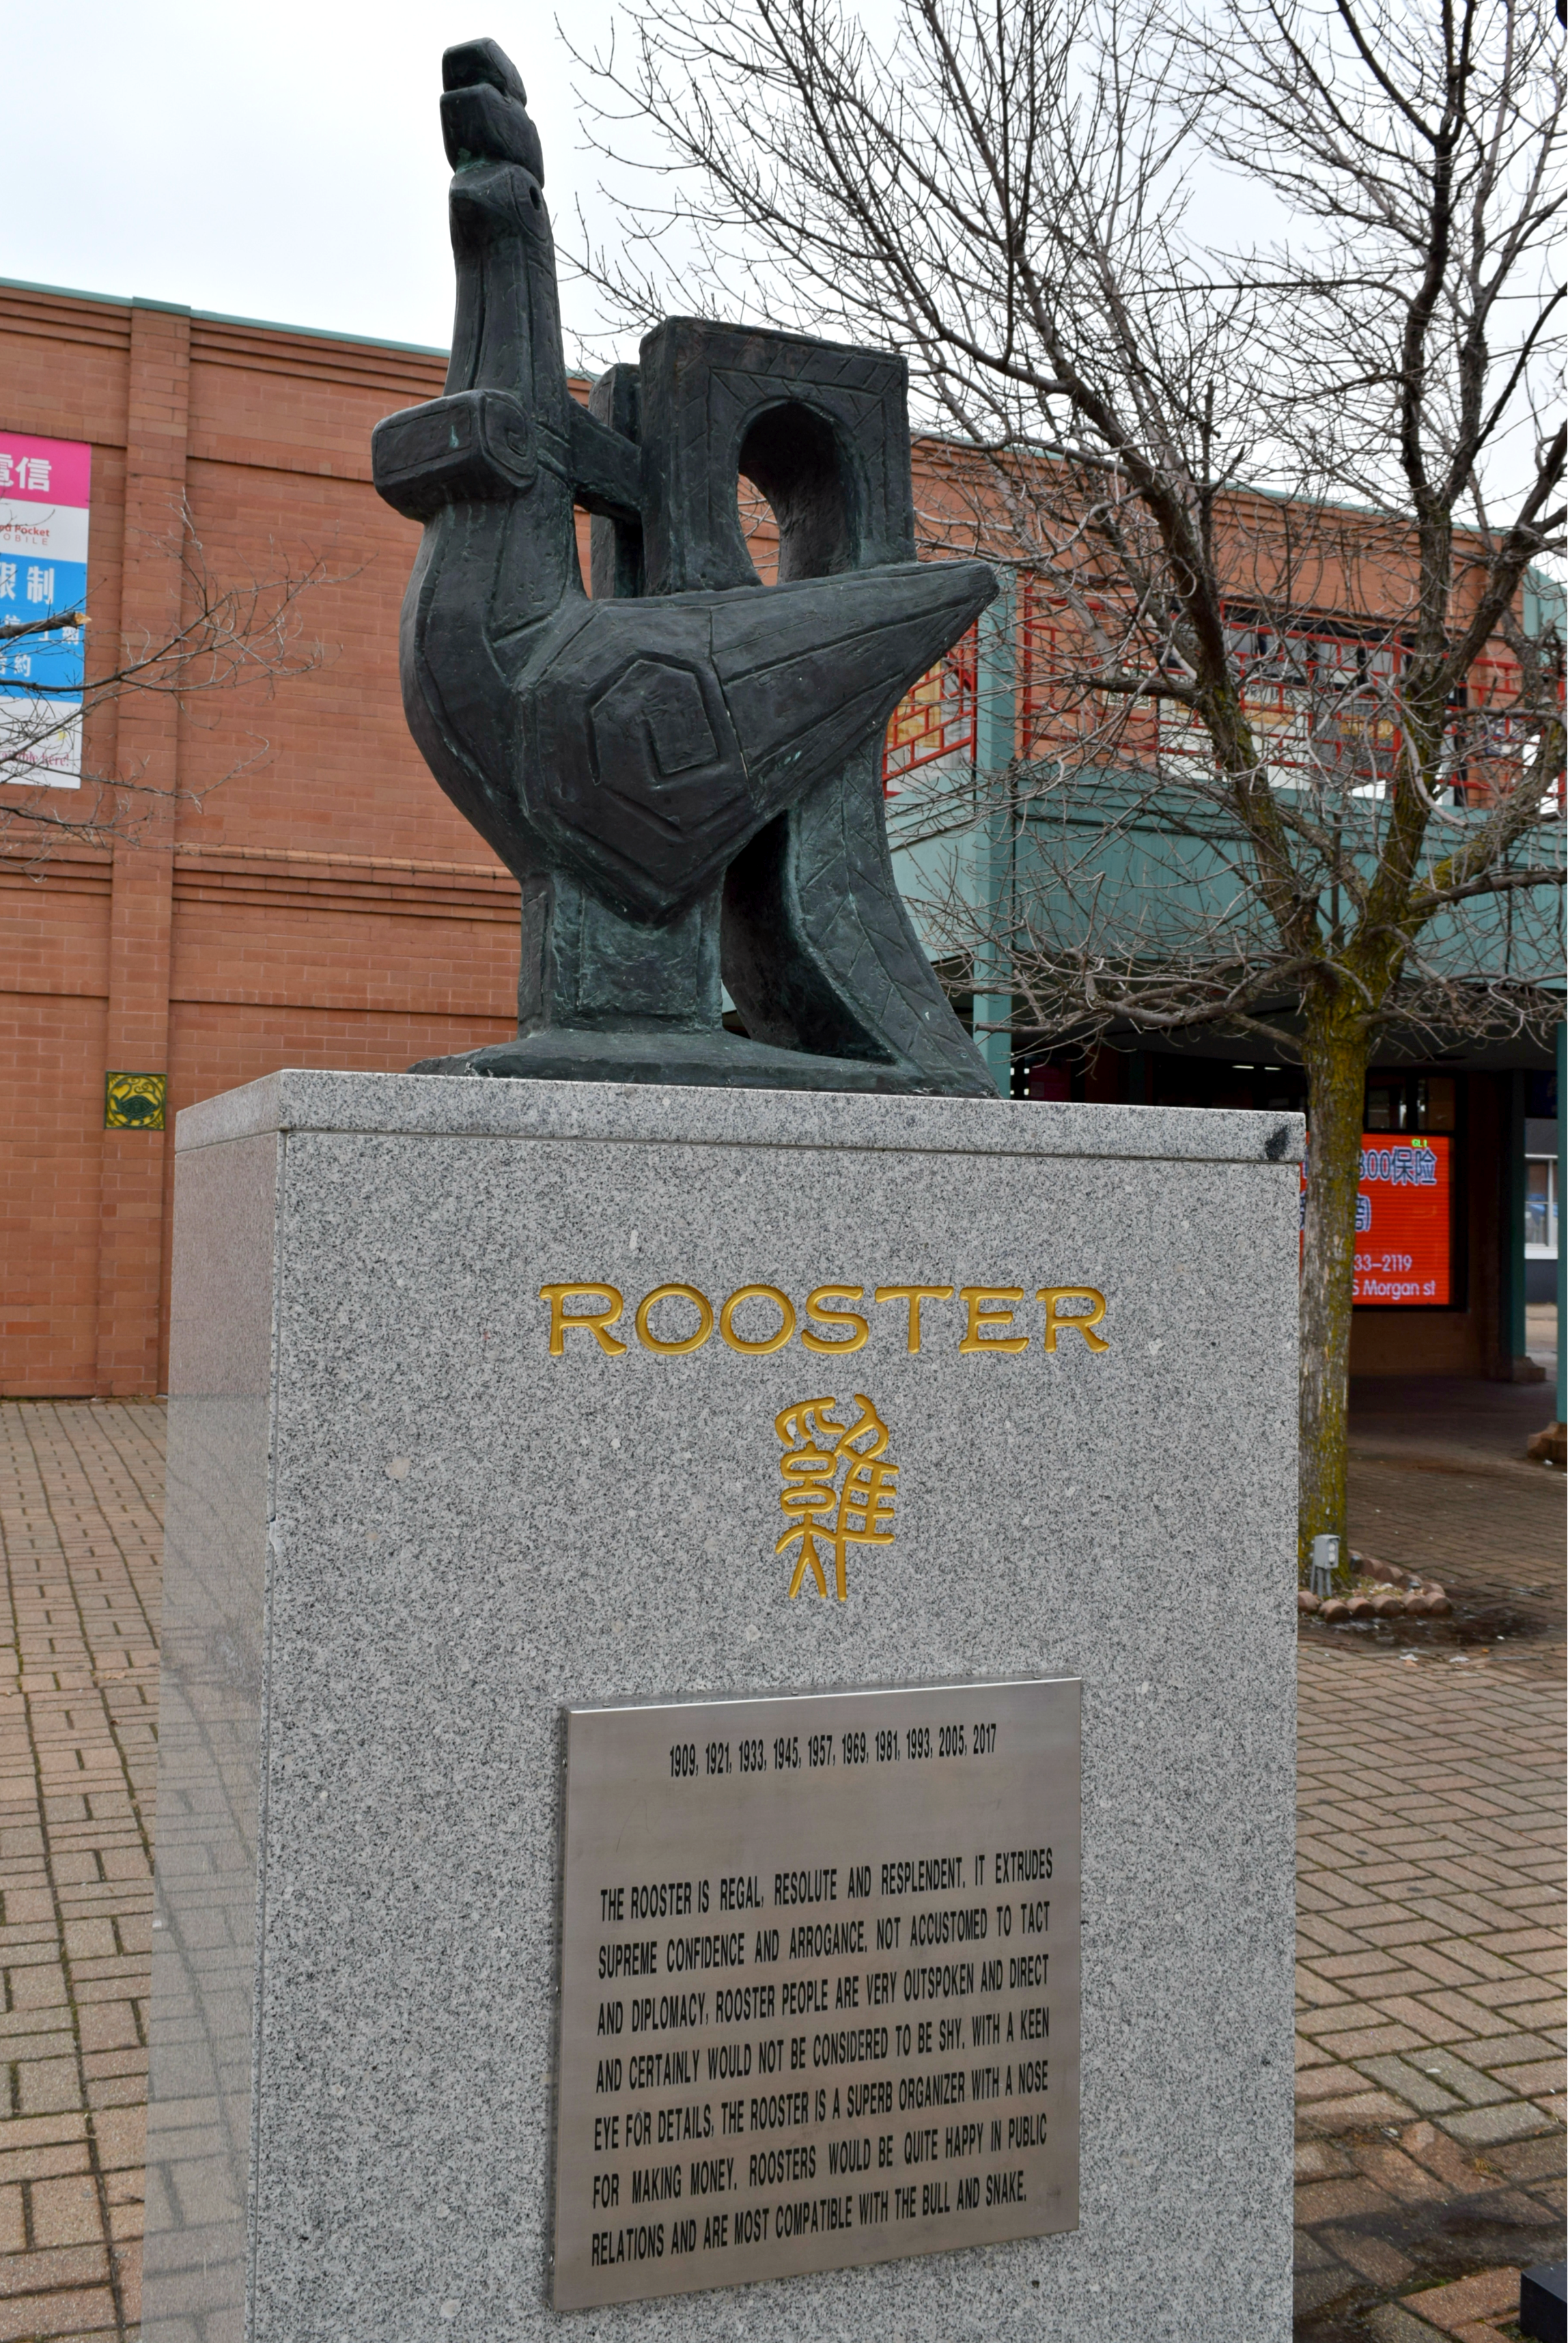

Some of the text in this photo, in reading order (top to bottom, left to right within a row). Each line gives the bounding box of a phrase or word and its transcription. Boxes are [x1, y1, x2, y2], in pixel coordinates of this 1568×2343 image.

[15, 524, 49, 537] Pocket
[539, 1283, 1109, 1356] ROOSTER
[1363, 1279, 1420, 1300] Morgan
[670, 1723, 996, 1777] 1909, 1921, 1933, 1945, 1957, 1969, 1981, 1993, 2005, 2017
[601, 1847, 1052, 1922] THE ROOSTER IS REGAL, RESOLUTE AND RESPLENDENT. IT EXTRUDES
[598, 1901, 1050, 1979] SUPREME CONFIDENCE AND ARROGANCE. NOT ACCUSTOMED TO TACT
[598, 1954, 1048, 2036] AND DIPLOMACY, ROOSTER PEOPLE ARE VERY OUTSPOKEN AND DIRECT
[596, 2007, 1049, 2093] AND CERTAINLY WOULD NOT BE CONSIDERED TO BE SHY. WITH A KEEN
[595, 2060, 1048, 2151] EYE FOR DETAILS, THE ROOSTER IS A SUPERB ORGANIZER WITH A NOSE
[593, 2113, 1046, 2209] FOR MAKING MONEY. ROOSTERS WOULD BE QUITE HAPPY IN PUBLIC
[592, 2170, 1026, 2266] RELATIONS AND ARE MOST COMPATIBLE WITH THE BULL AND SNAKE.
